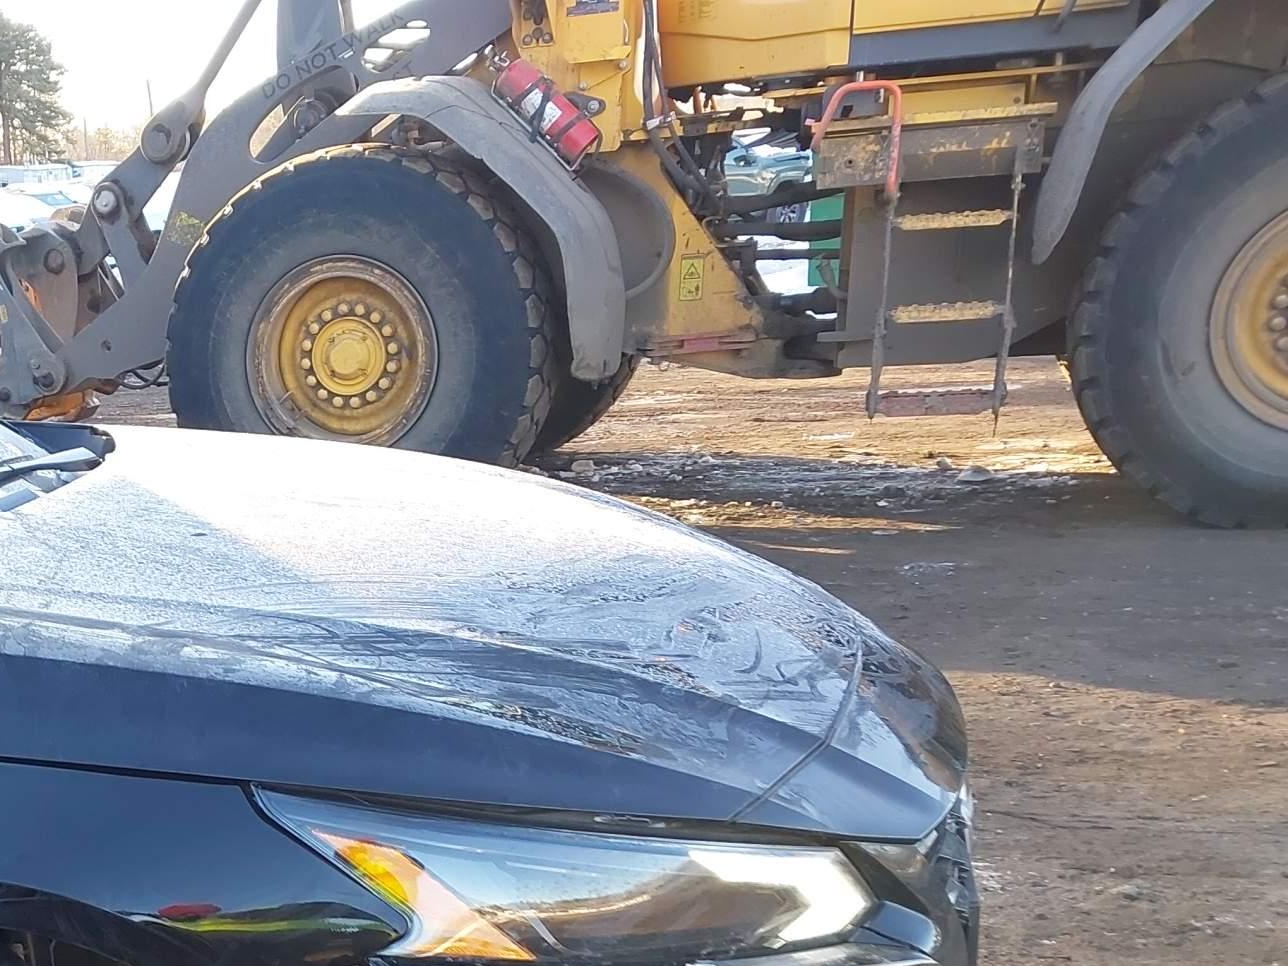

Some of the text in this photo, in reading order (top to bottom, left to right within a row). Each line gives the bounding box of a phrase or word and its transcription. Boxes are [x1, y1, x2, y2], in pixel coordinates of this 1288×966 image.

[262, 12, 404, 99] DO NOT WALK
